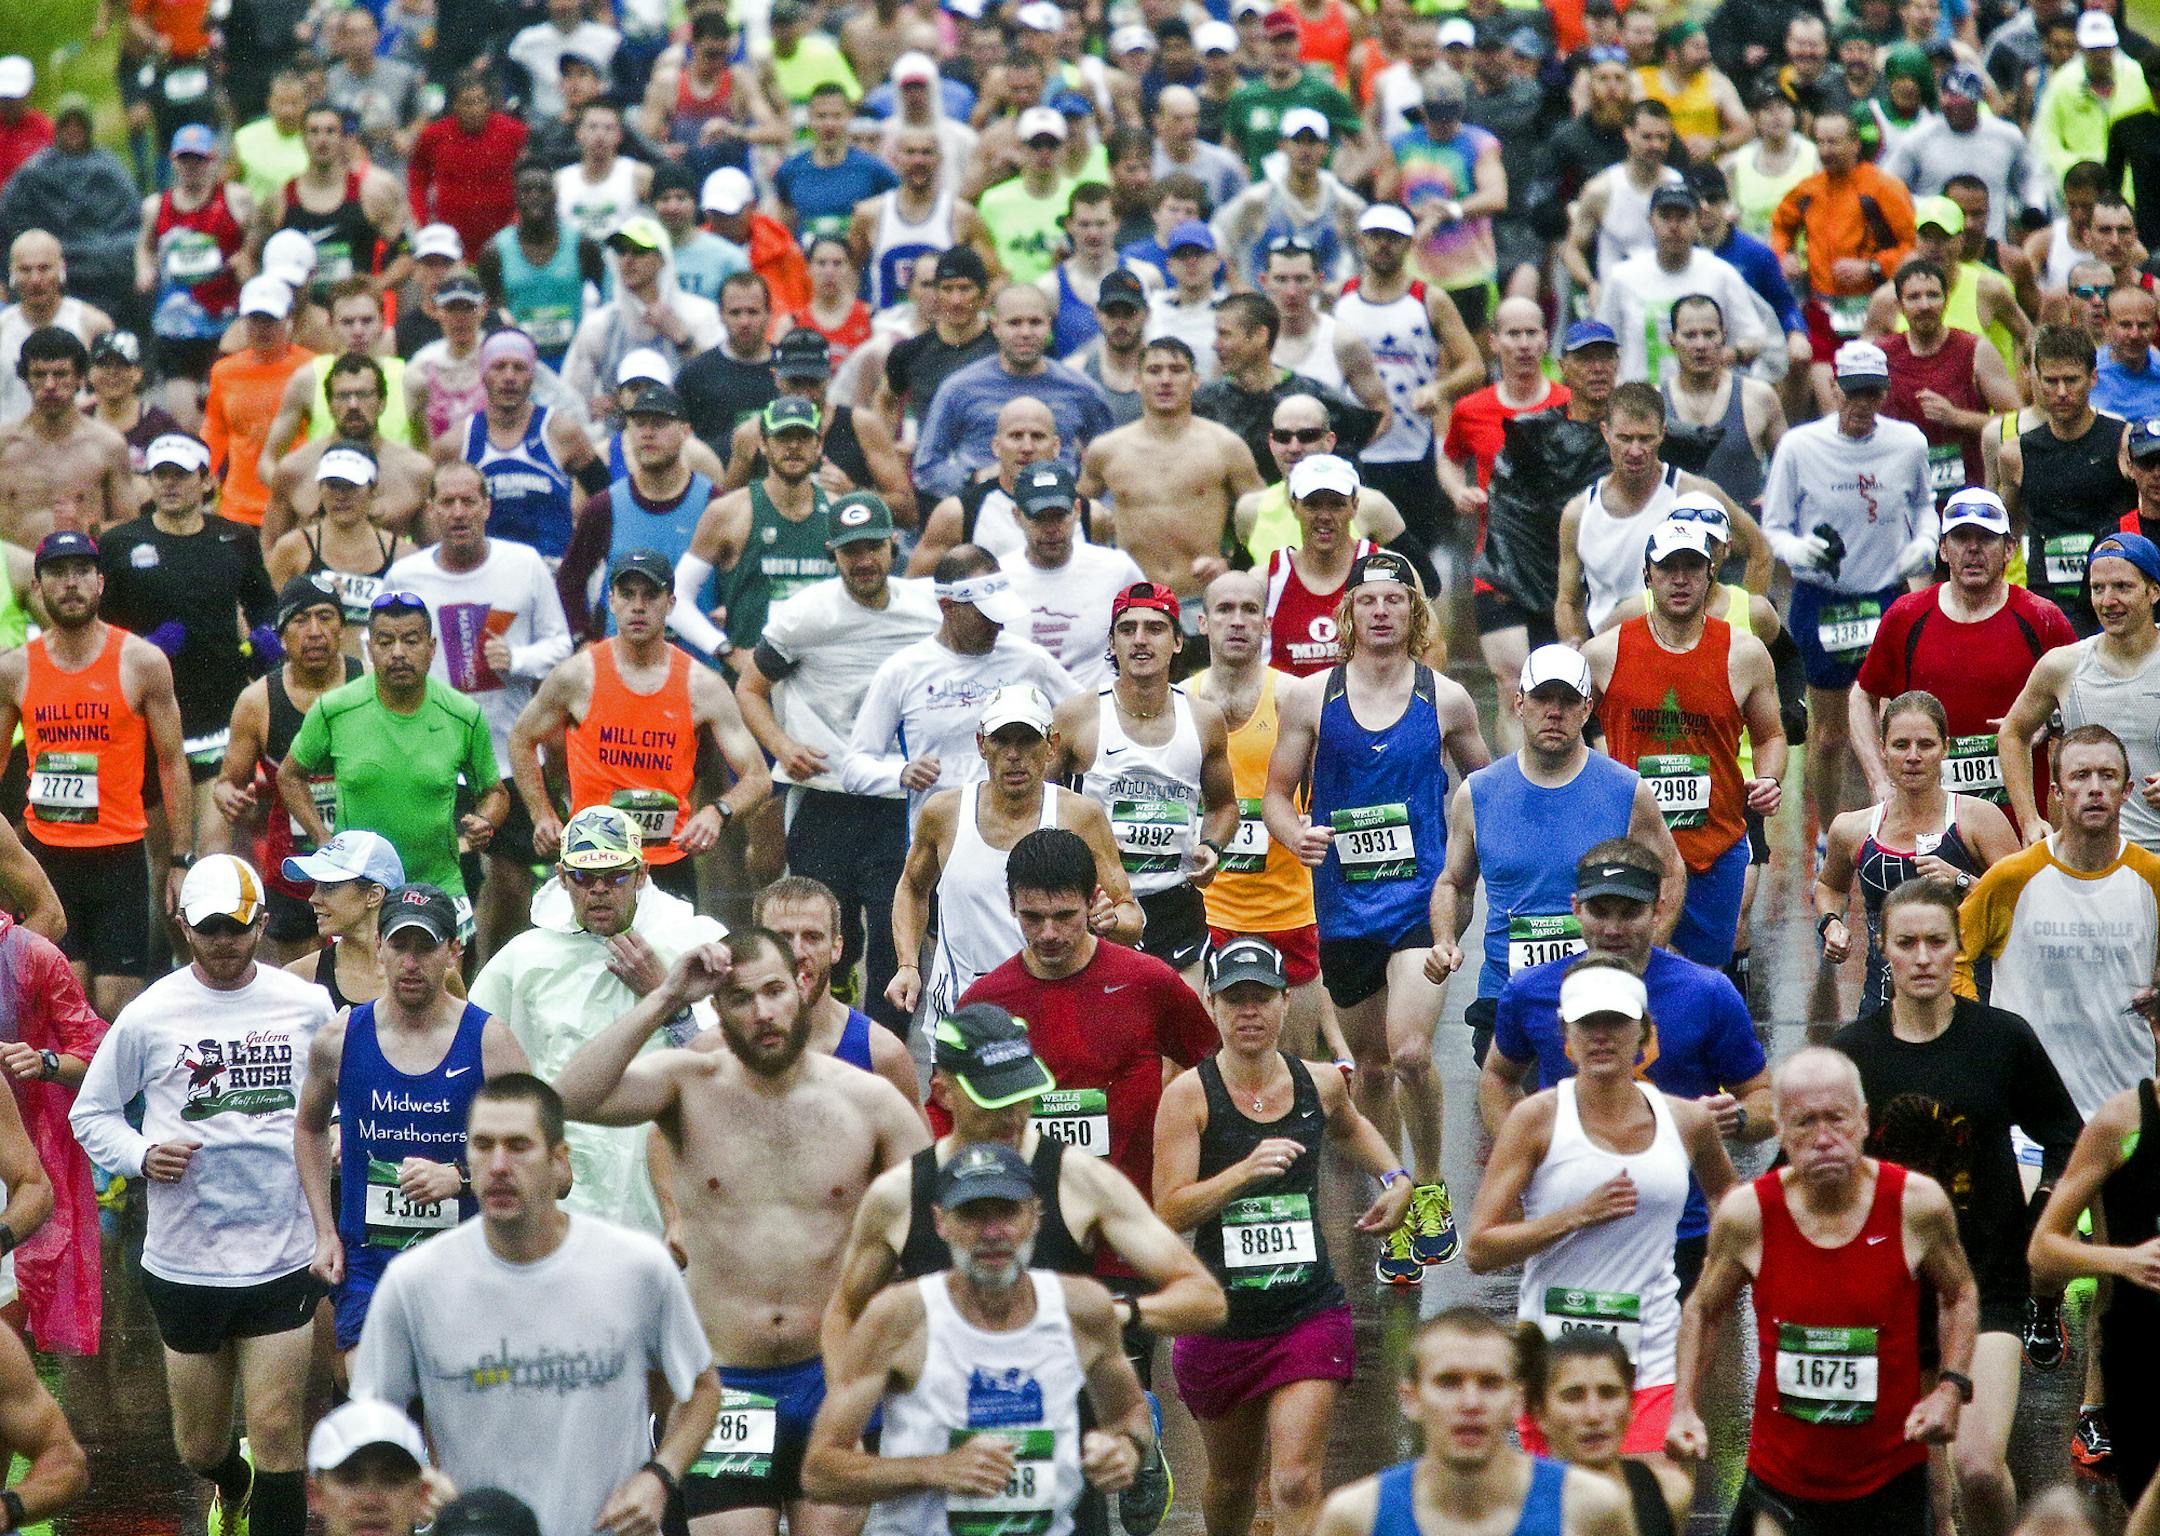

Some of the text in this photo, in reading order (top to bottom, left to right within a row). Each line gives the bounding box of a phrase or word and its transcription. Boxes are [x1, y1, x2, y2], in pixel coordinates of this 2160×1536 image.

[1831, 624, 1868, 645] 3383
[35, 703, 110, 722] MILL CITY
[37, 725, 110, 743] RUNNING
[600, 726, 677, 750] MILL CITY
[599, 747, 674, 771] RUNNING
[1952, 758, 1998, 783] 1081
[42, 776, 84, 799] 2772
[1652, 779, 1698, 802] 2998
[1134, 802, 1169, 811] WELLS
[1135, 810, 1168, 820] FARGO
[1350, 807, 1385, 819] WELLS
[1352, 816, 1386, 828] FARGO
[1125, 824, 1176, 848] 3892
[1349, 829, 1398, 855] 3931
[1528, 918, 1565, 928] WELLS
[1531, 927, 1565, 937] FARGO
[1523, 942, 1574, 968] 3106
[228, 1040, 292, 1066] LEAD
[229, 1065, 293, 1089] RUSH
[370, 1089, 451, 1114] Midwest
[1040, 1093, 1081, 1103] WELLS
[1043, 1102, 1082, 1113] FARGO
[358, 1117, 469, 1144] Marathoners
[1240, 1226, 1298, 1255] 8891
[1795, 1359, 1858, 1390] 1675
